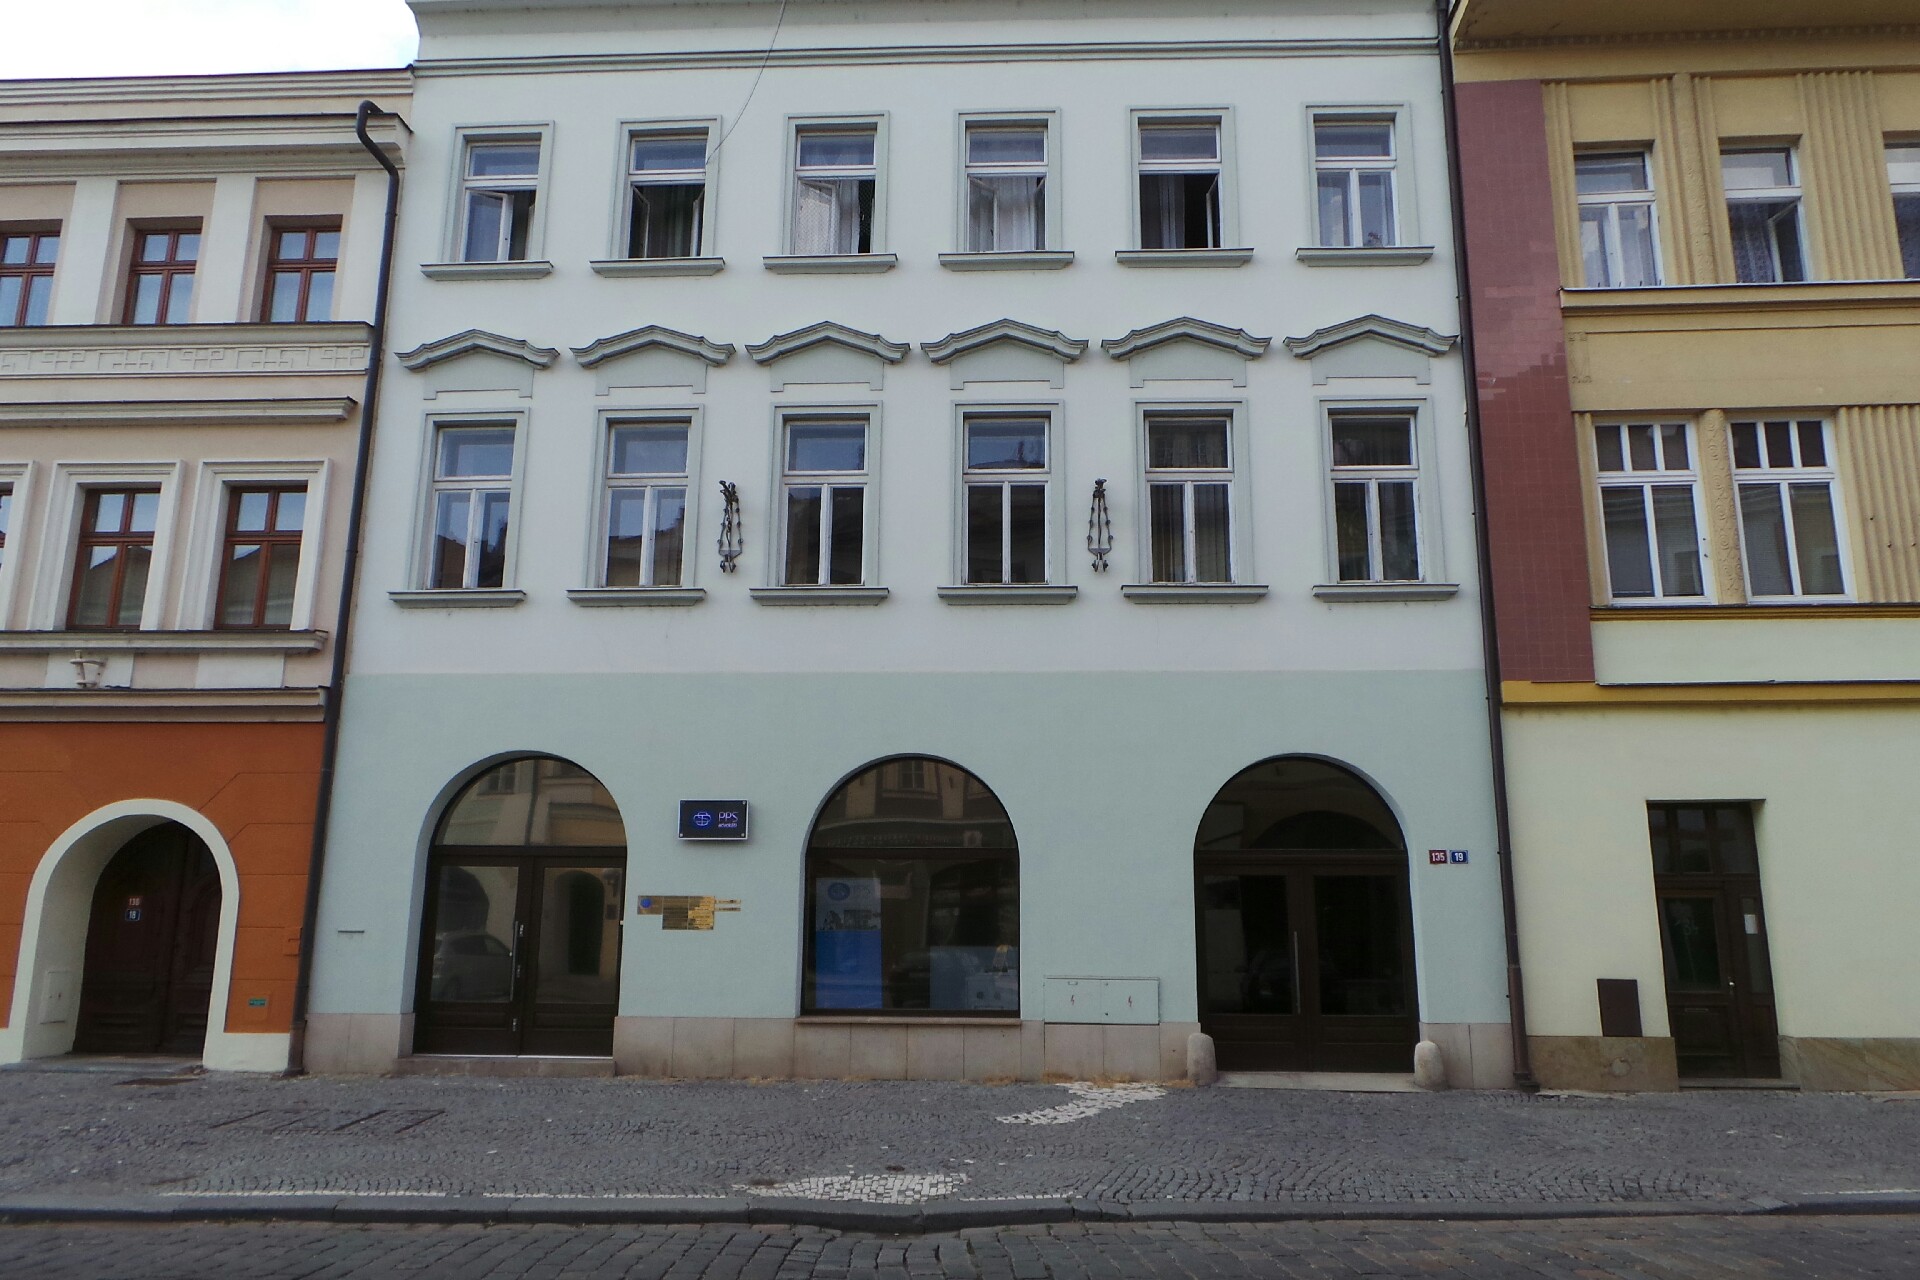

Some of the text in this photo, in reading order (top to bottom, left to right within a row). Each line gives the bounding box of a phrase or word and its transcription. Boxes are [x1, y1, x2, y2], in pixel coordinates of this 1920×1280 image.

[718, 811, 738, 823] PPS
[1432, 852, 1445, 862] 135
[1455, 852, 1464, 862] 19
[129, 910, 136, 919] 18
